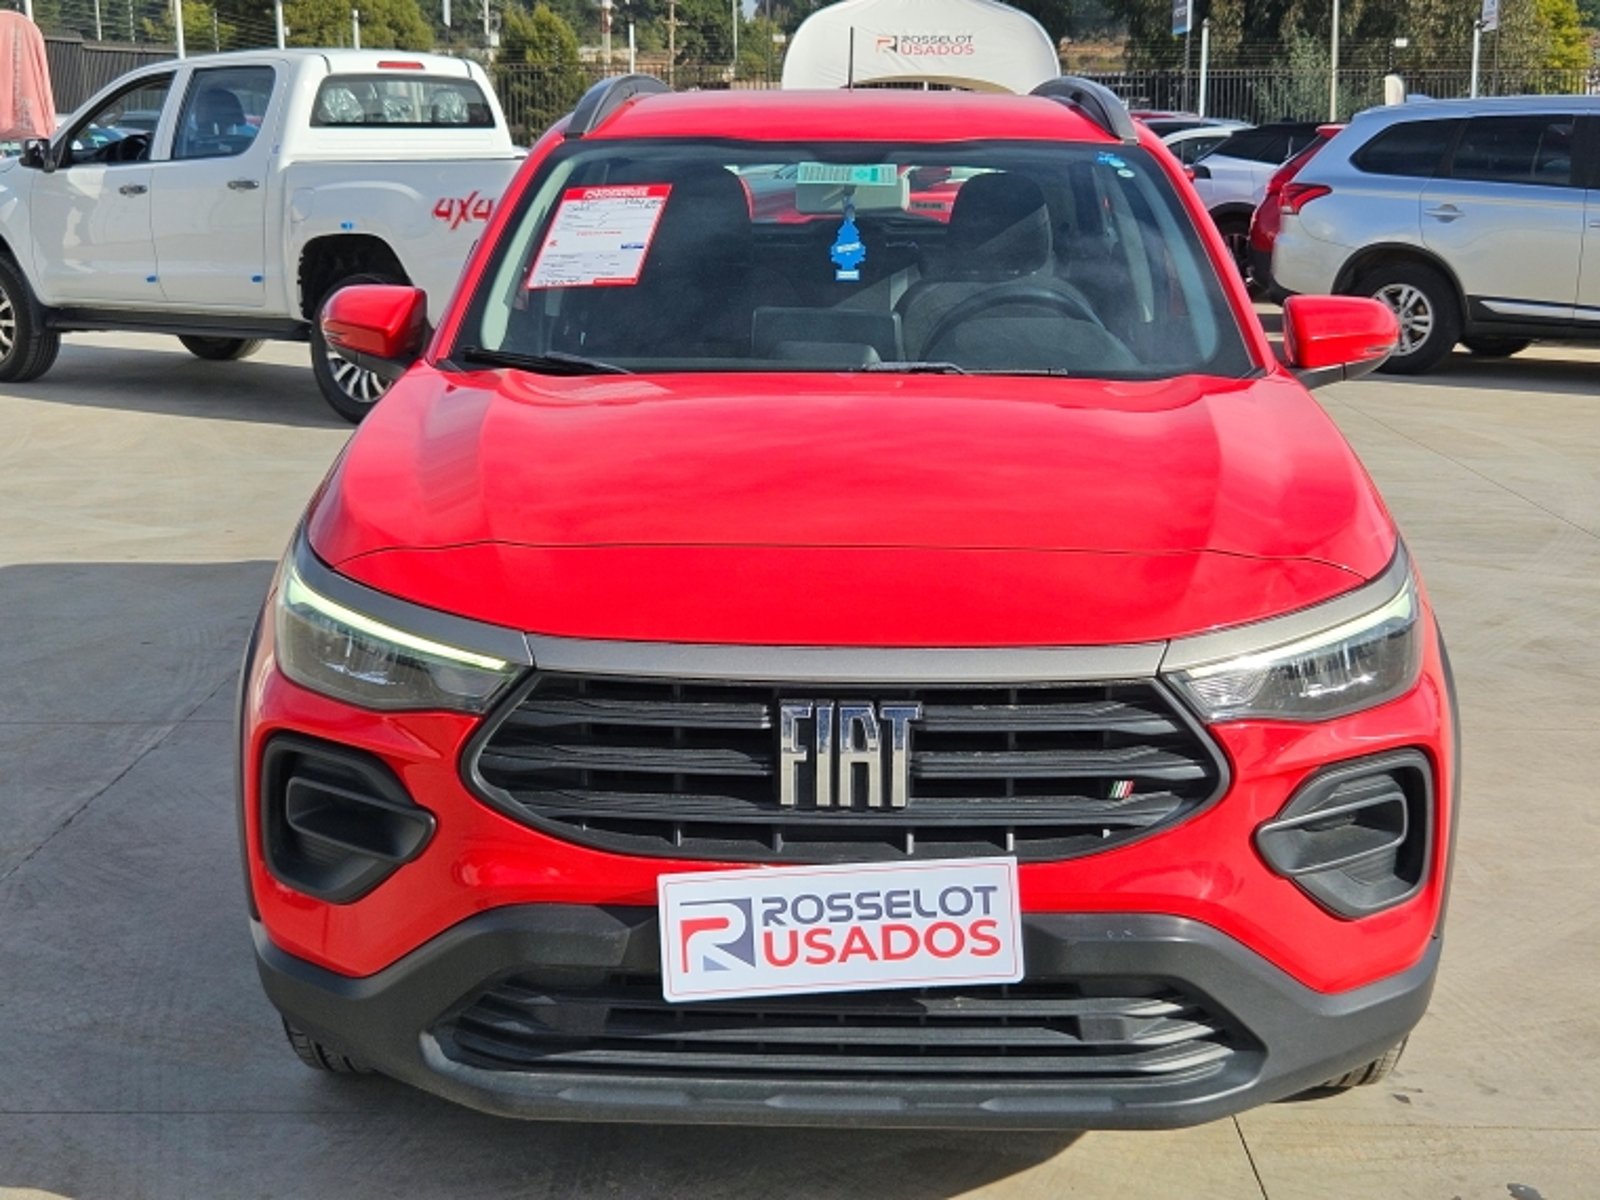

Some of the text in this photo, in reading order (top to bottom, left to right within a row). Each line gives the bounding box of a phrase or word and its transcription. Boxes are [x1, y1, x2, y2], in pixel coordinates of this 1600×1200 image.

[901, 35, 974, 45] ROSSELOT
[901, 44, 975, 55] USADOS
[780, 700, 922, 808] FIAT
[761, 885, 998, 927] ROSSELOT
[763, 919, 1001, 967] USADOS
